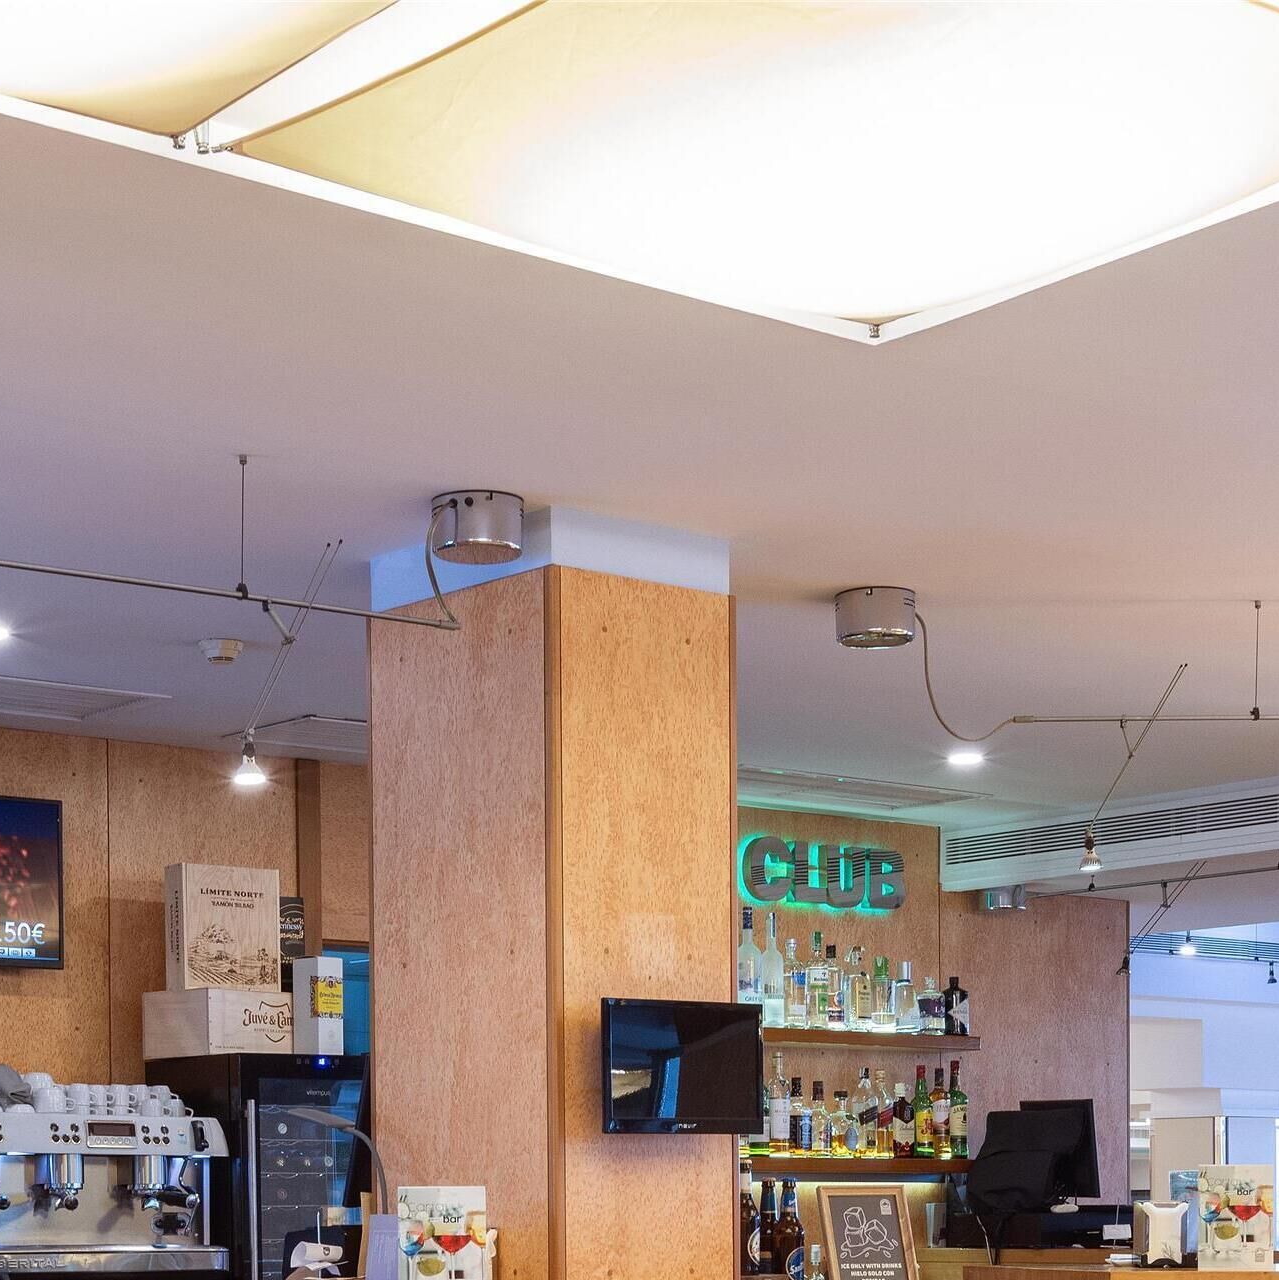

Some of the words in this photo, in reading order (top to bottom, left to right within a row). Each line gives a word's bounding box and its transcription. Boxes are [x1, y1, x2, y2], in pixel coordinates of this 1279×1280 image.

[742, 836, 907, 910] CLUB
[200, 888, 232, 896] LÍMITE
[243, 1008, 268, 1027] Juvé
[269, 1011, 276, 1022] &
[1236, 1188, 1252, 1196] bar
[443, 1215, 462, 1224] bar
